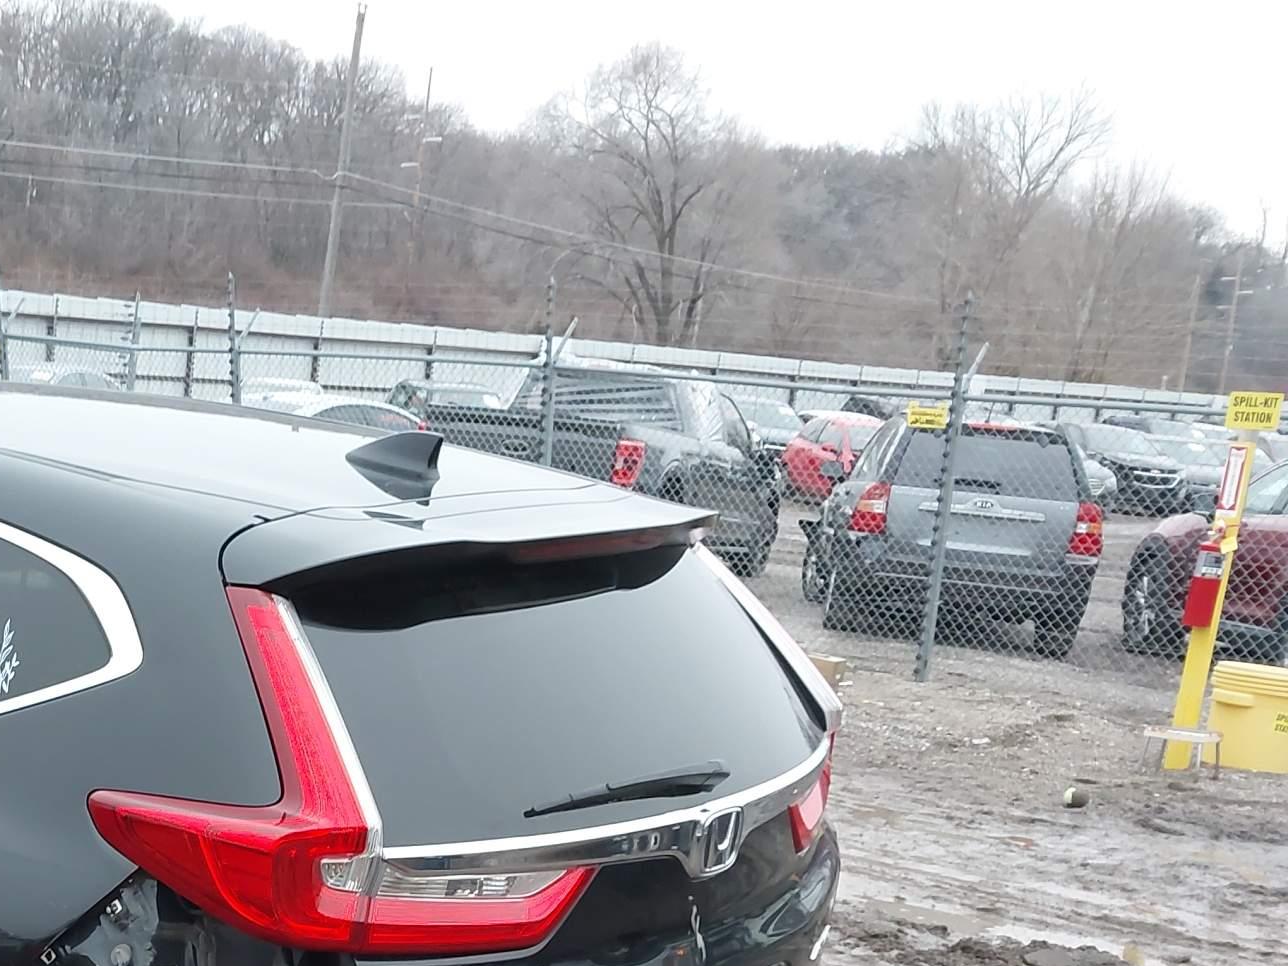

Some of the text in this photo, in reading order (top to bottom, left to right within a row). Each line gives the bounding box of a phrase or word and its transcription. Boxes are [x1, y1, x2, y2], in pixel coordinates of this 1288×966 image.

[1232, 396, 1280, 408] SPILL-KIT
[1233, 411, 1273, 423] STATION
[975, 501, 993, 509] KIA
